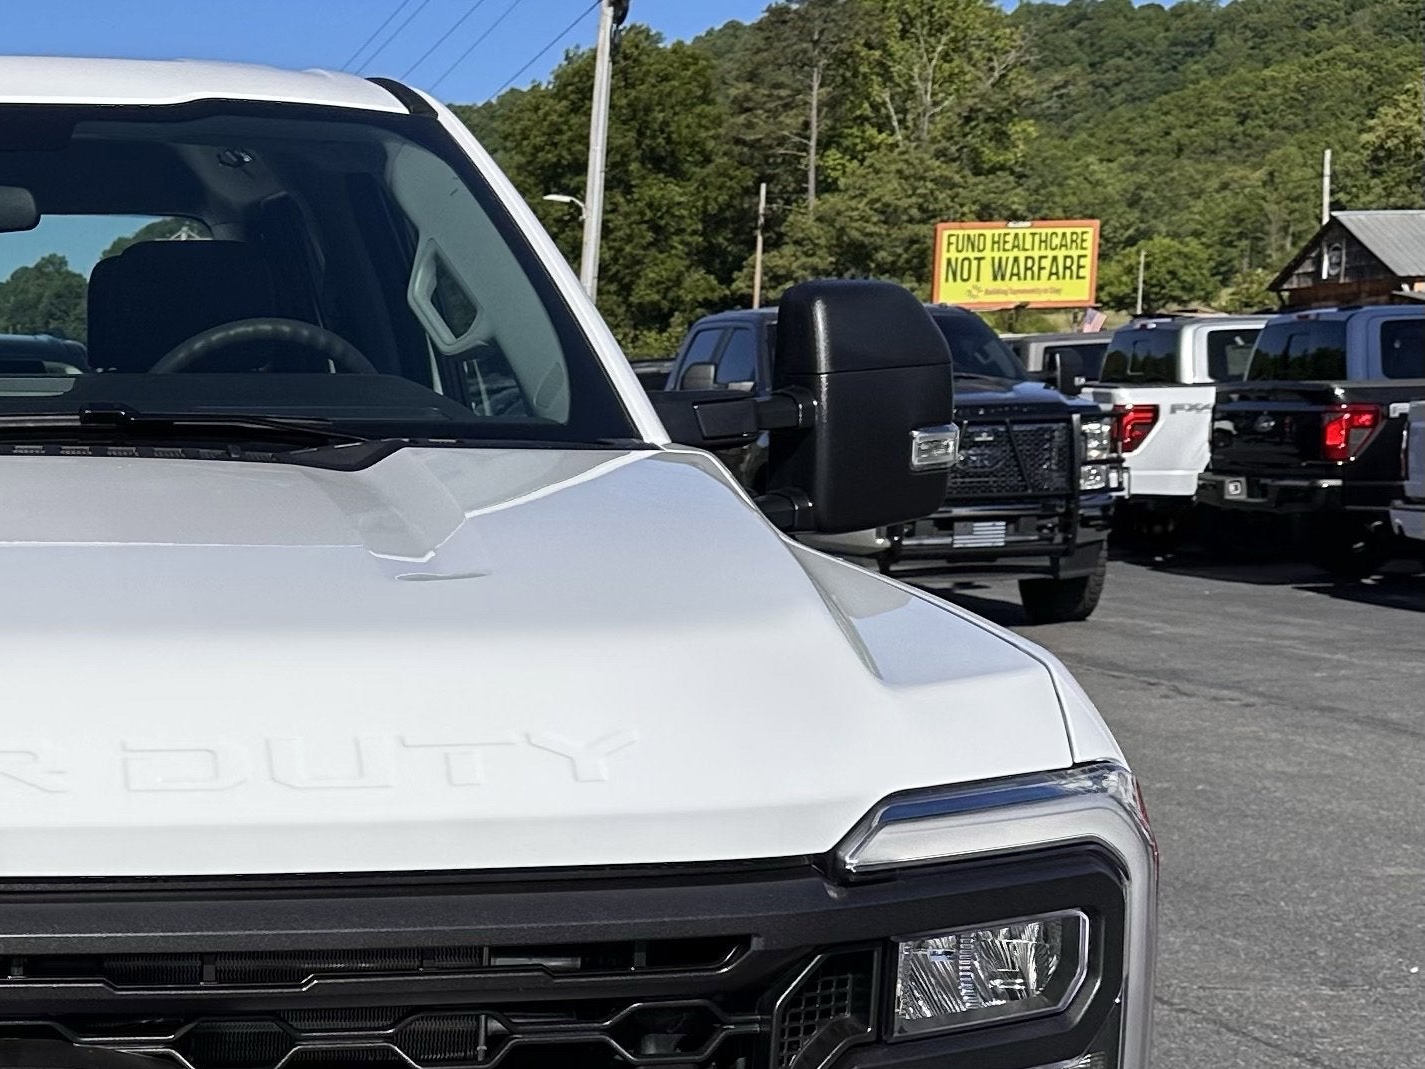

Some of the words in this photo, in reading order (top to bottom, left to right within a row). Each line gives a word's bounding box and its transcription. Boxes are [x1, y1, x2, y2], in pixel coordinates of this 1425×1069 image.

[946, 233, 986, 253] FUND
[990, 231, 1089, 252] HEALTHCARE
[945, 256, 986, 282] NOT
[991, 254, 1088, 281] WARFARE
[116, 726, 641, 791] DUTY
